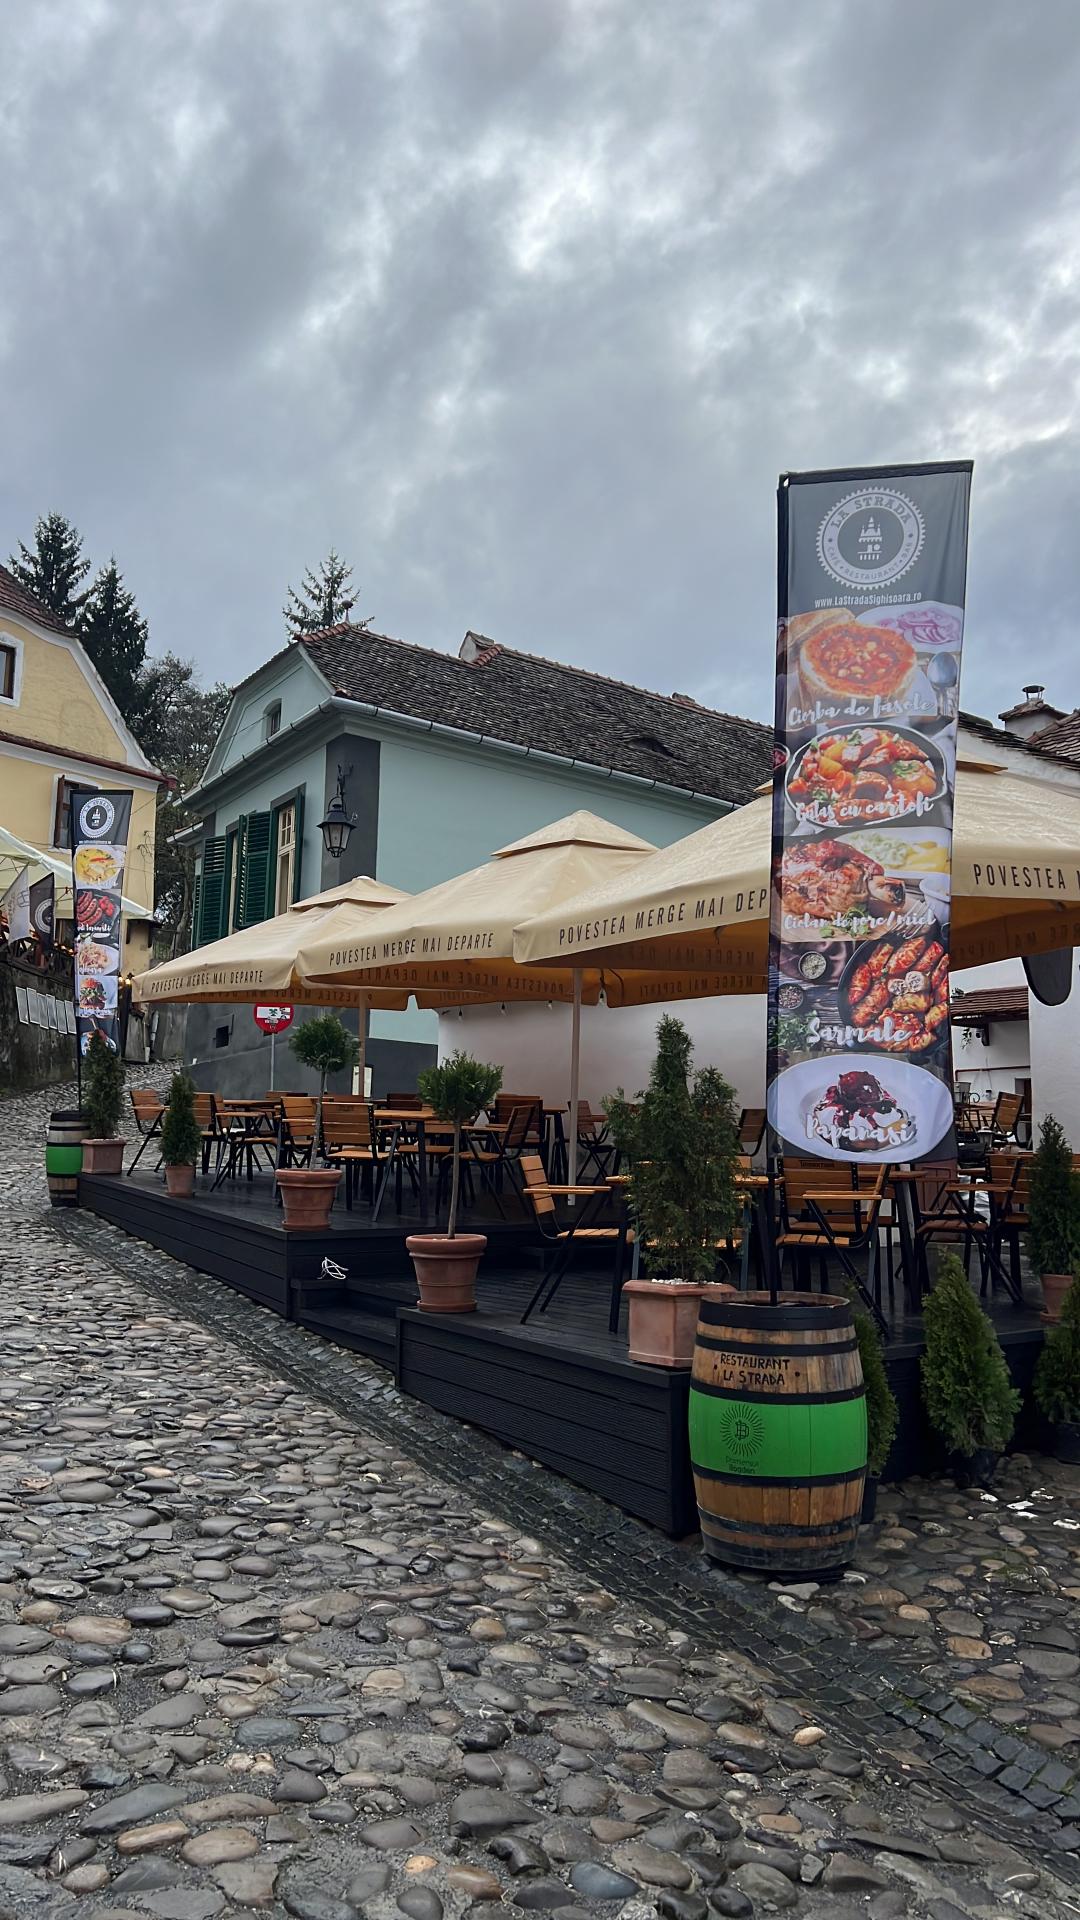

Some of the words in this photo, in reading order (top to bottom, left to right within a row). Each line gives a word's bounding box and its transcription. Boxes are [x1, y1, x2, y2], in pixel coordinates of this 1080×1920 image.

[830, 509, 850, 528] LA
[855, 495, 912, 524] STRADA
[814, 591, 922, 609] www.LaStradaSighisoara.ro
[788, 700, 840, 726] Ciorba
[843, 698, 870, 717] de
[872, 692, 936, 719] fasole
[839, 803, 863, 818] cu
[865, 790, 935, 818] cartofi
[973, 863, 1067, 890] POVESTEA
[558, 915, 626, 946] POVESTEA
[635, 902, 686, 930] MERGE
[695, 896, 724, 919] MAI
[735, 887, 768, 913] DEP
[329, 946, 378, 968] POVESTEA
[383, 938, 417, 959] MERGE
[422, 936, 441, 953] MAI
[447, 932, 495, 951] DEPARTE
[151, 978, 184, 993] POVESTEA
[213, 971, 226, 985] MAI
[230, 970, 264, 984] DEPARTE
[806, 1016, 912, 1047] Sarmale
[804, 1114, 917, 1149] Papanasi
[720, 1352, 790, 1370] RESTAURANT
[722, 1369, 734, 1382] LA
[739, 1371, 785, 1386] STRADA
